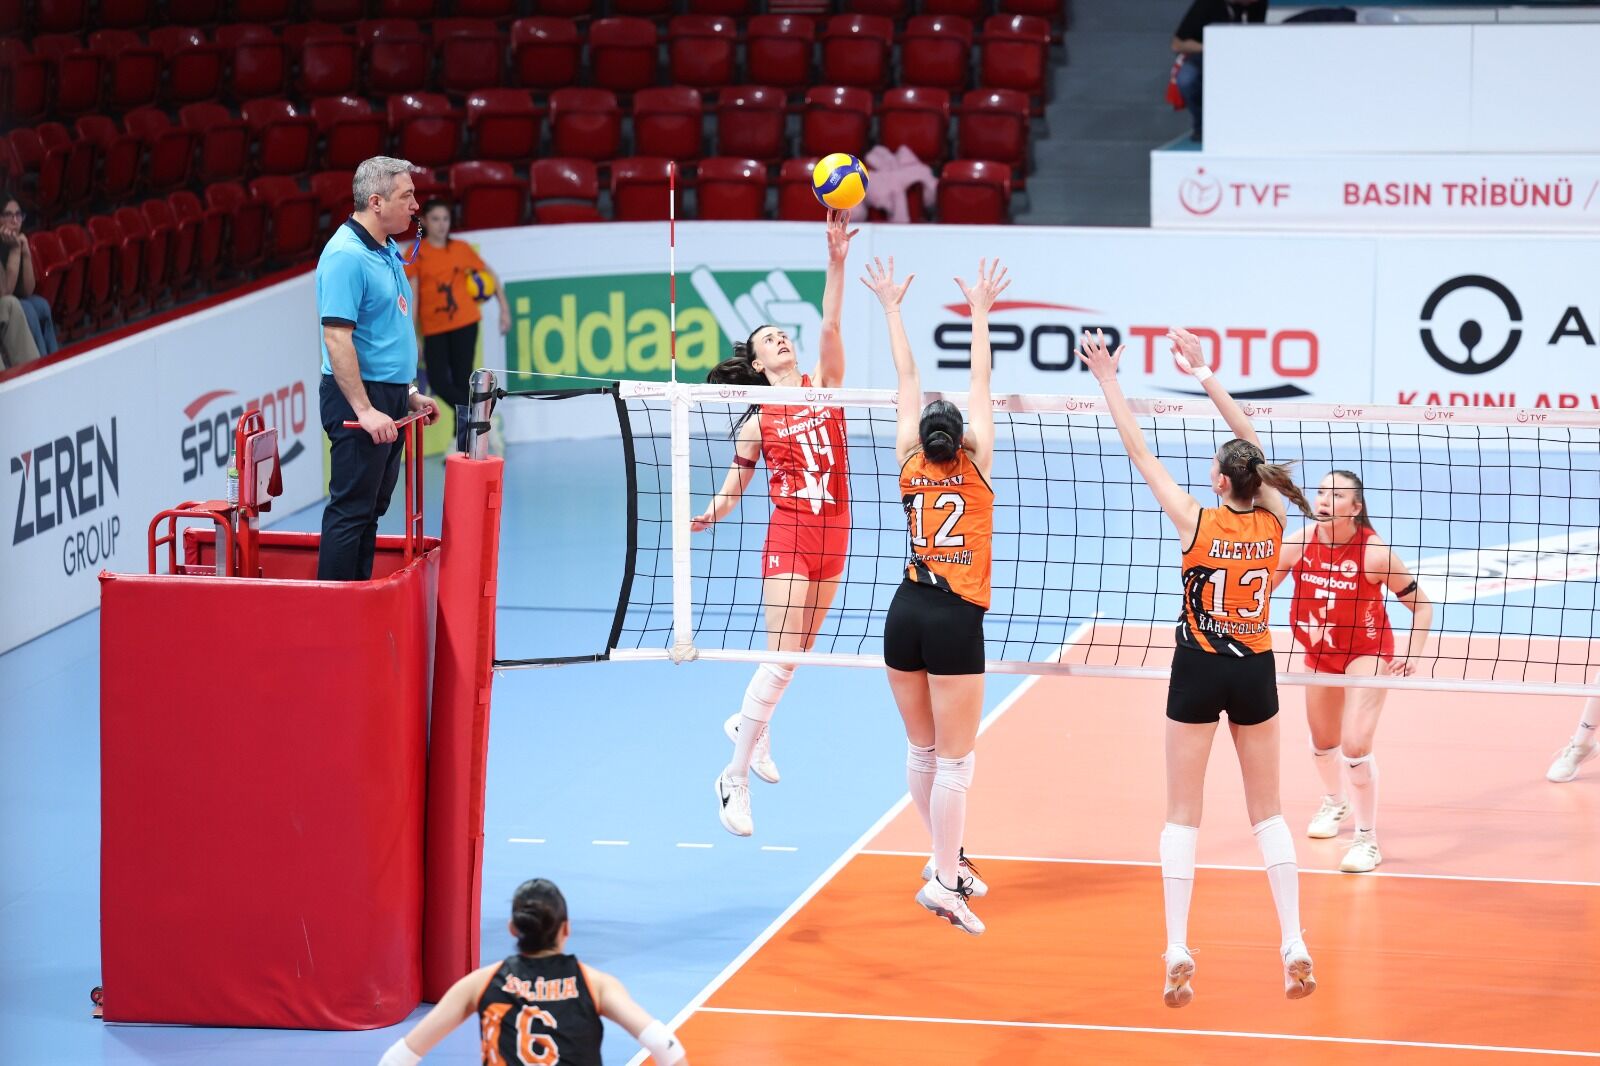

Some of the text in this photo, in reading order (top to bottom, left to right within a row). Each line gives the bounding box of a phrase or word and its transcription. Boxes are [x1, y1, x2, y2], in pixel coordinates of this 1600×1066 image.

[1230, 183, 1291, 207] TVF
[1344, 183, 1432, 206] BASIN
[1442, 177, 1573, 206] TRİBÜNÜ
[516, 291, 720, 380] iddaa
[796, 425, 835, 472] 14
[10, 416, 119, 546] ZEREN
[63, 515, 120, 577] GROUP
[912, 493, 966, 548] 12
[1208, 539, 1275, 560] ALEYNA
[1206, 567, 1271, 618] 13
[1314, 588, 1337, 619] 7
[515, 1004, 559, 1066] 6
